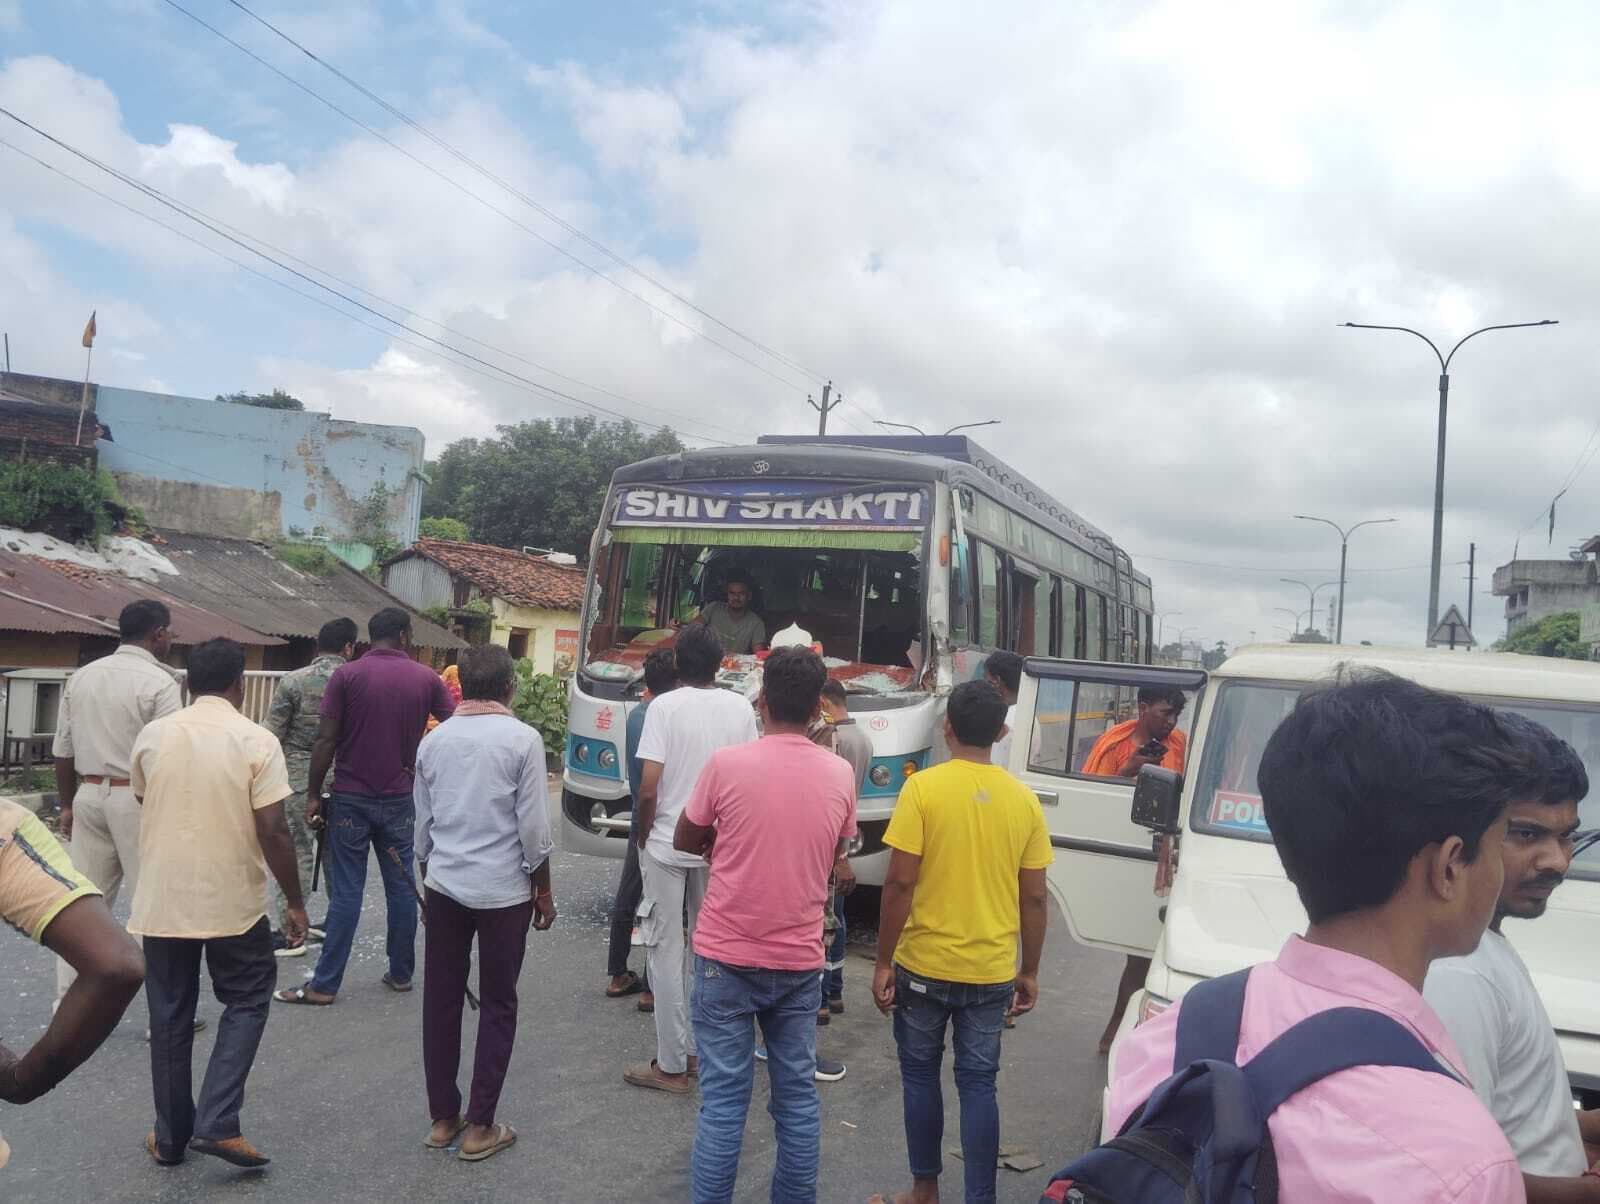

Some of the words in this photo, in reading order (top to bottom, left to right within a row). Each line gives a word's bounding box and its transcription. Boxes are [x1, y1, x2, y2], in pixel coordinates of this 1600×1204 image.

[625, 490, 730, 518] SHIV
[740, 492, 922, 519] SHAKTI
[1218, 800, 1265, 825] POL
